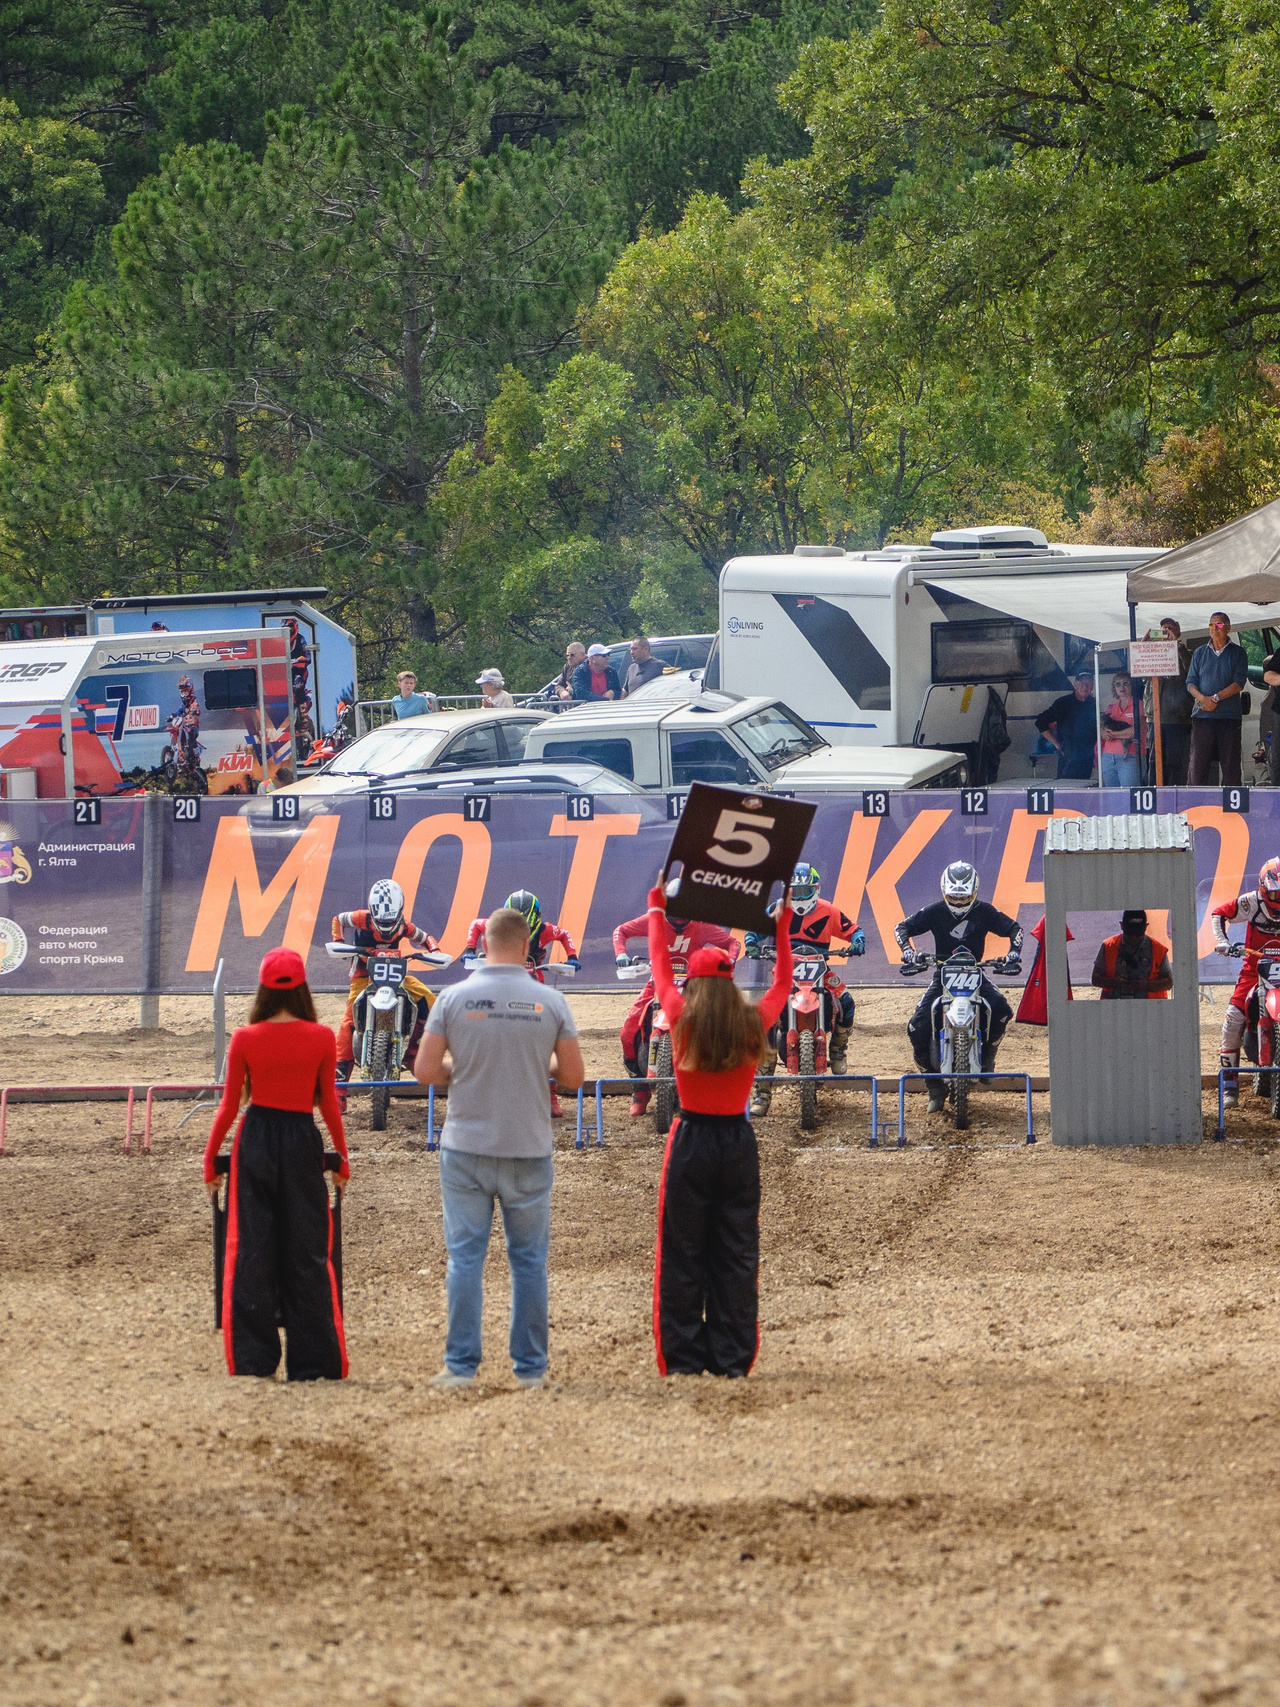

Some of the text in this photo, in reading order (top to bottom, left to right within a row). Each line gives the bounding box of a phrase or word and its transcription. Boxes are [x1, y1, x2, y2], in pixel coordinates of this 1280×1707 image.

[727, 620, 764, 631] SUNLIVING
[105, 684, 130, 742] 7
[128, 707, 157, 728] А.СУШКО
[218, 752, 253, 773] KTM
[175, 799, 197, 820] 20
[277, 798, 296, 818] 19
[374, 797, 392, 817] 18
[468, 798, 486, 818] 17
[571, 797, 590, 817] 16
[866, 793, 886, 813] 13
[965, 792, 984, 812] 12
[1031, 791, 1049, 811] 11
[1134, 791, 1153, 810] 10
[1230, 790, 1241, 810] 9
[76, 802, 96, 822] 21
[38, 843, 135, 853] Администрация
[706, 808, 775, 868] 5
[38, 857, 77, 866] г. Ялта
[691, 869, 763, 896] СЕКУНД
[39, 925, 108, 936] Федерация
[39, 941, 97, 949] авто мото
[39, 954, 124, 965] спорта Крыма
[373, 963, 402, 982] 95
[945, 973, 980, 990] 744
